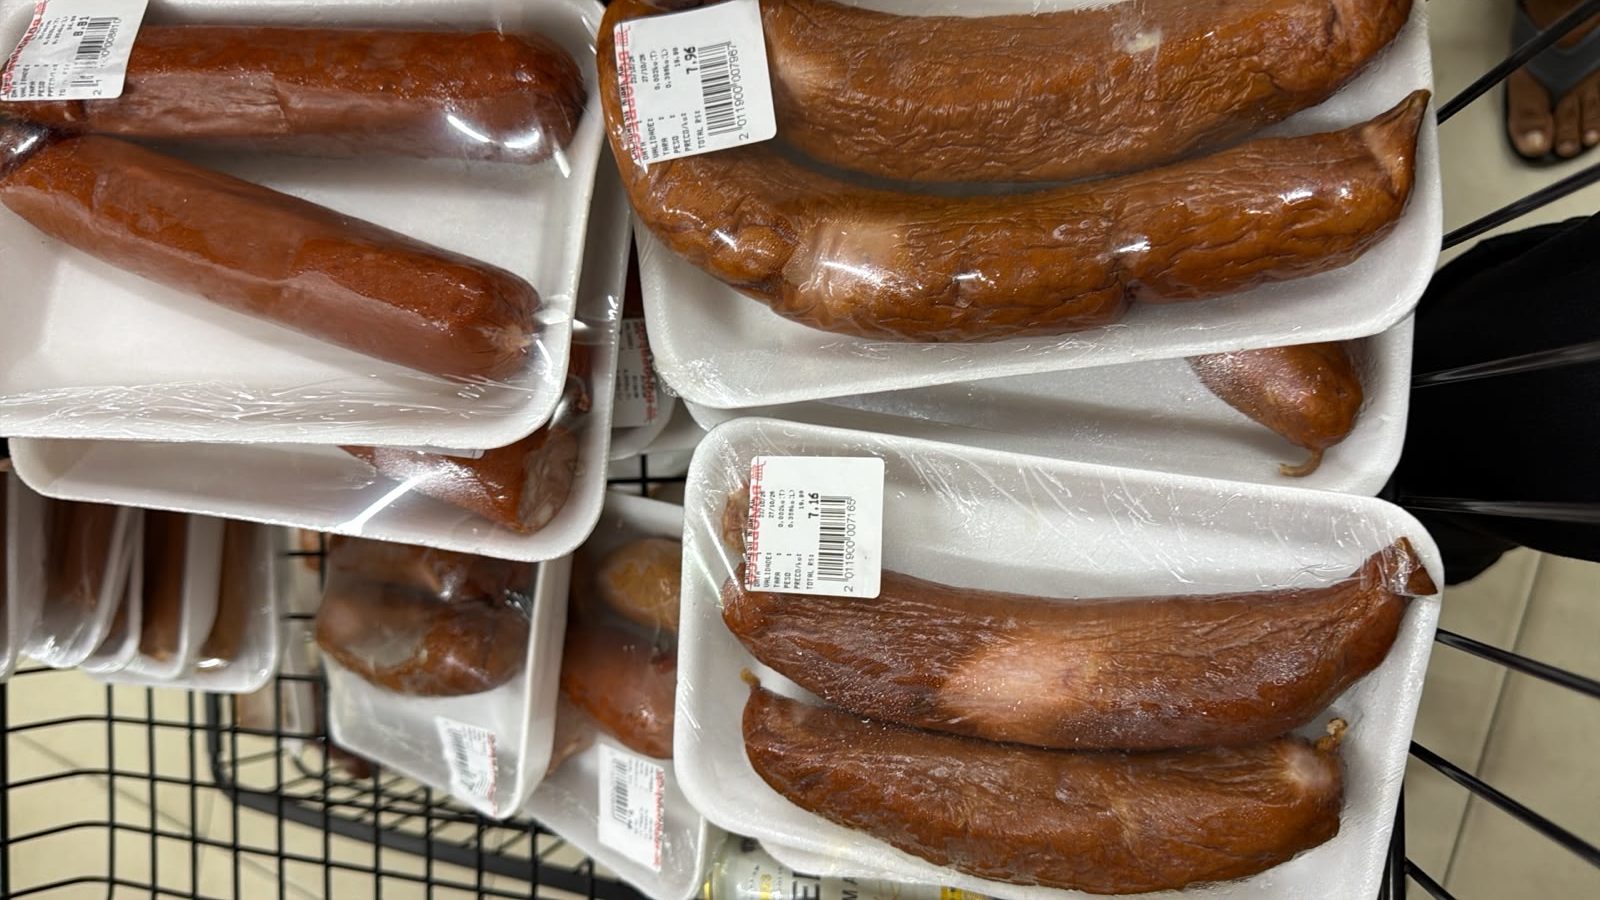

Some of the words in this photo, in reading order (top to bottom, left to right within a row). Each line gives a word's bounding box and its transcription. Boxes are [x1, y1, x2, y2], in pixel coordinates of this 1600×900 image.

[73, 16, 90, 37] 8.81
[672, 135, 680, 154] PESO
[696, 127, 706, 149] TOTAL
[738, 131, 749, 141] 2
[661, 137, 669, 156] TARA
[808, 492, 820, 519] 7.16
[773, 572, 781, 588] TARA
[784, 572, 792, 589] PESO
[806, 571, 815, 590] TOTAL
[844, 585, 854, 593] 2
